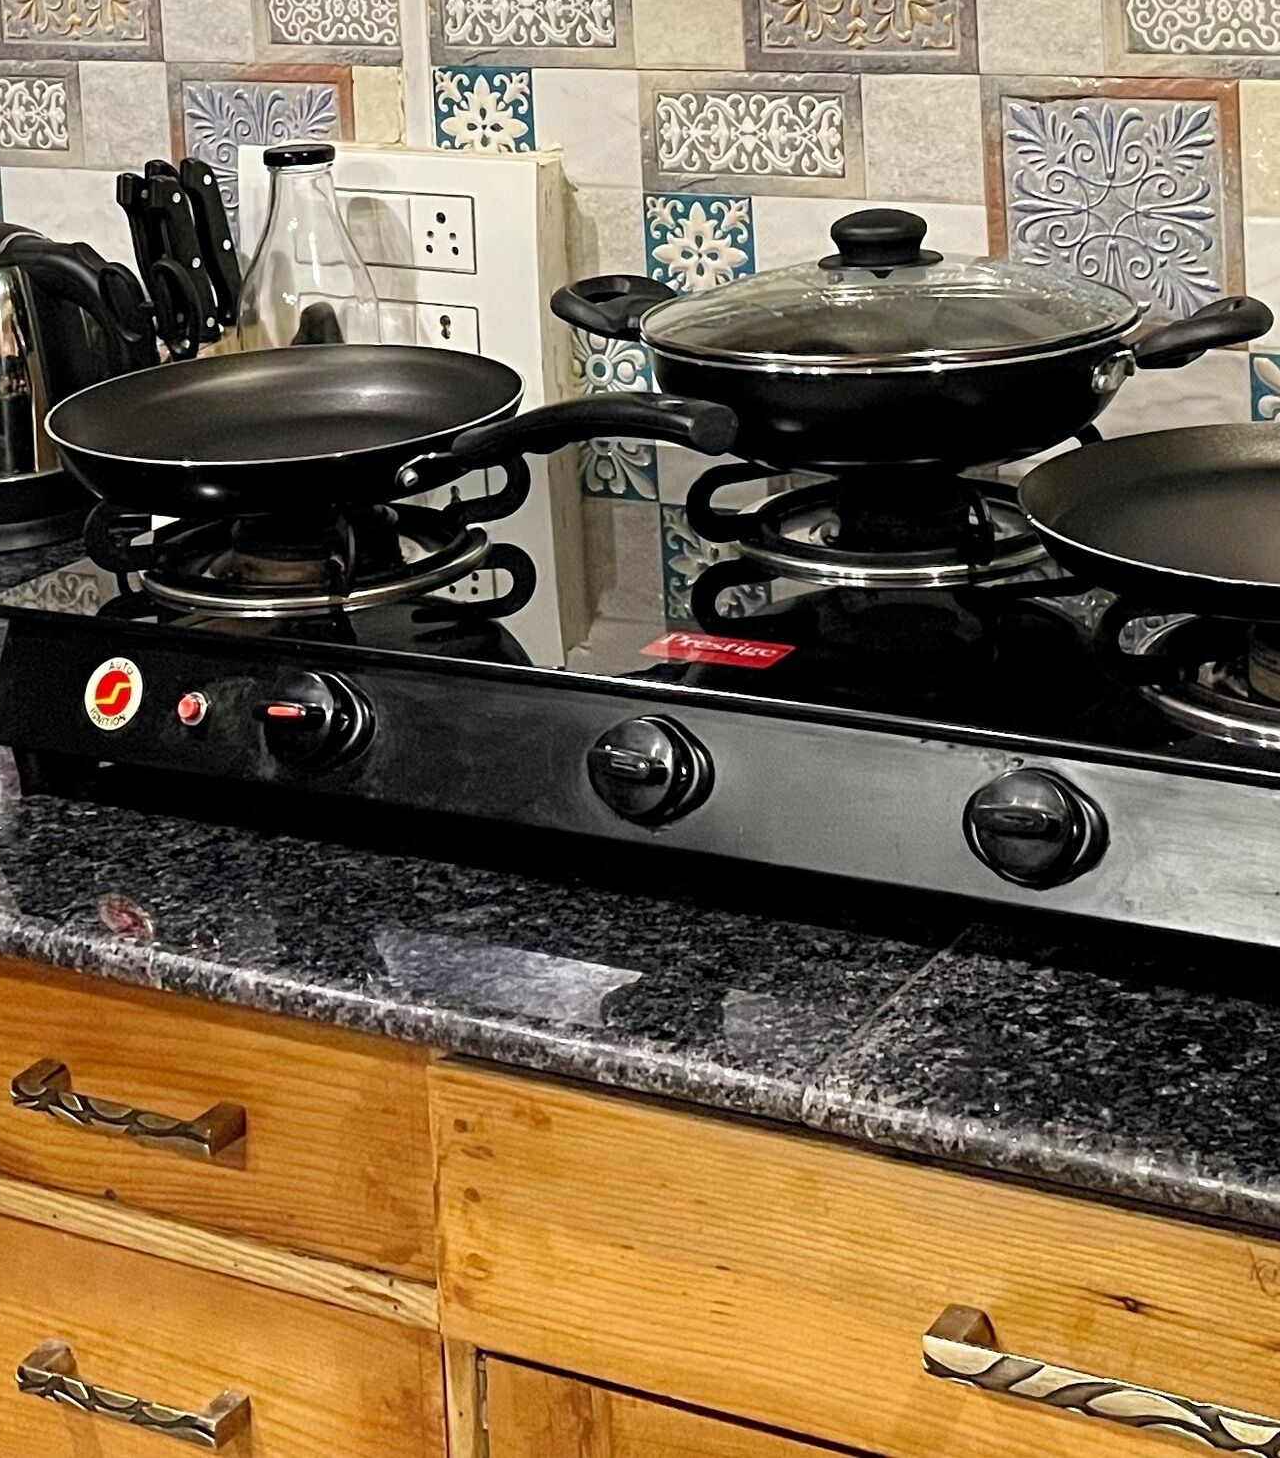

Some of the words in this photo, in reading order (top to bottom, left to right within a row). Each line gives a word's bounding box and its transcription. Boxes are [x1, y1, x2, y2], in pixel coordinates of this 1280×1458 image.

[659, 633, 778, 657] Prestige
[109, 661, 134, 675] AUTO
[89, 707, 126, 726] IGNITION
